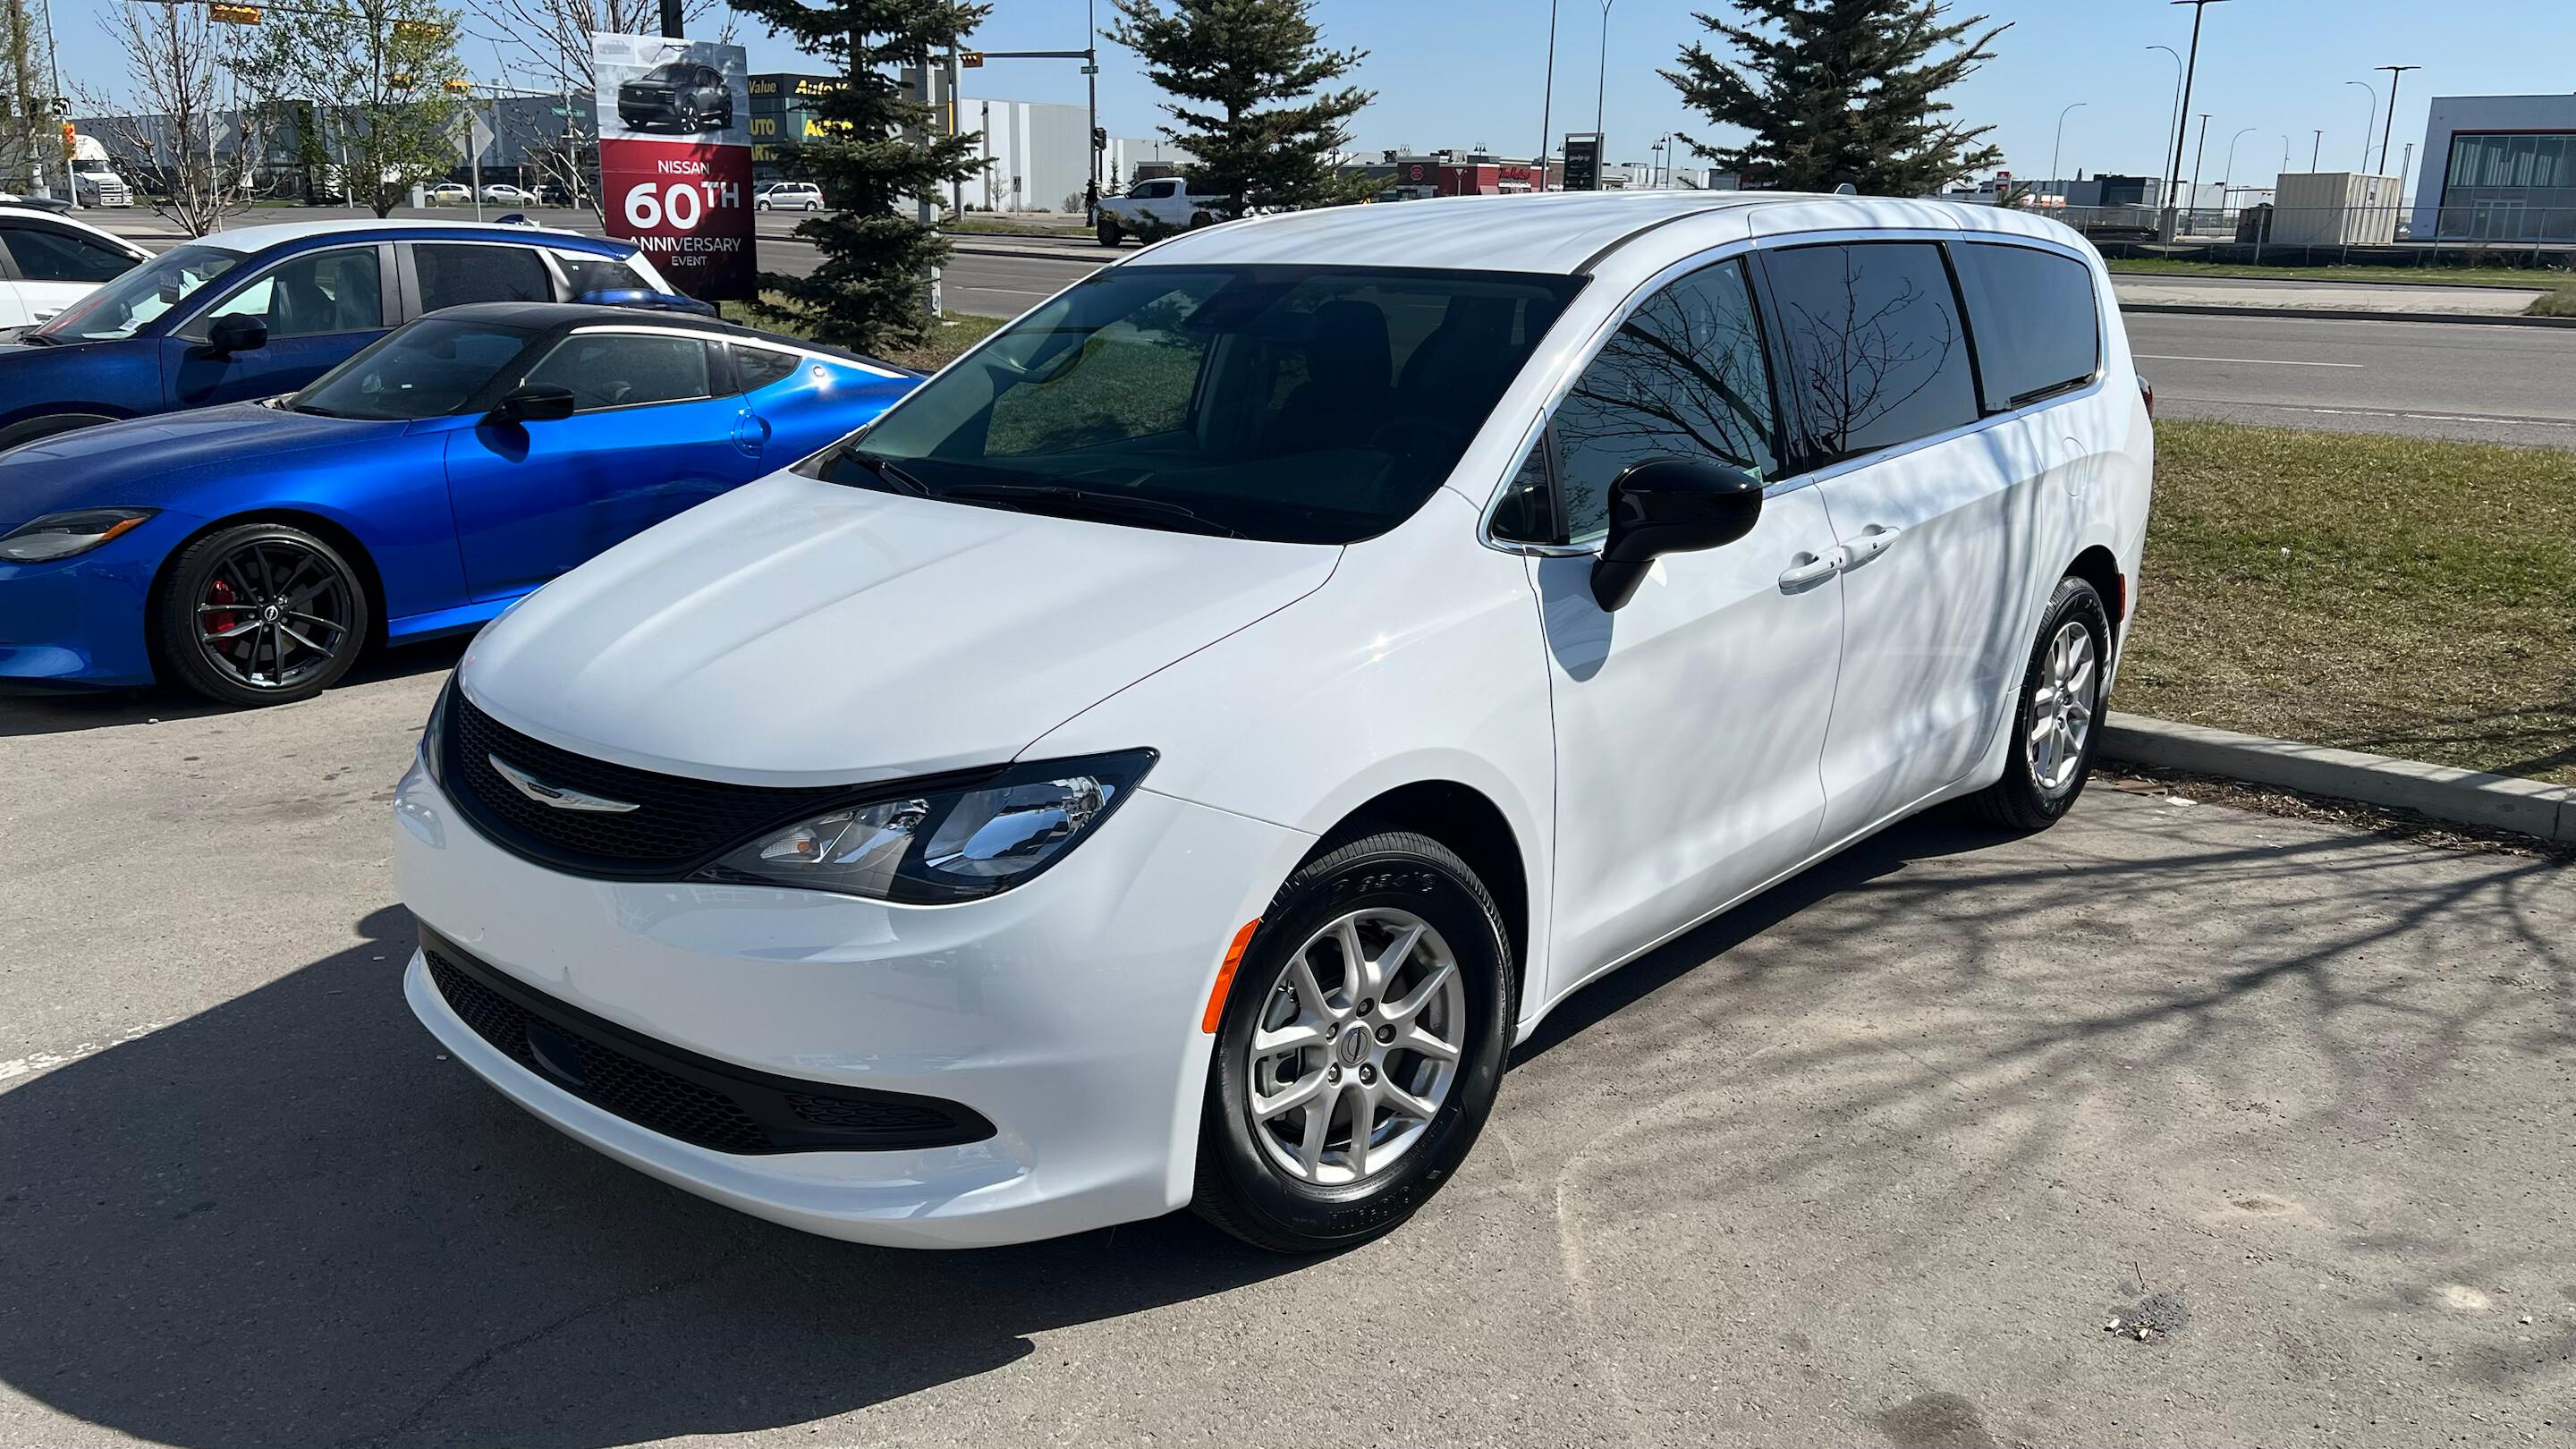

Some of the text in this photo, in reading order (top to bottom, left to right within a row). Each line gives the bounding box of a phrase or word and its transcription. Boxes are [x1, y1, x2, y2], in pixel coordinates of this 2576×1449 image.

[749, 80, 777, 94] Value
[750, 118, 775, 136] UTO
[657, 159, 710, 175] NISSAN
[624, 181, 740, 230] 60TH
[671, 255, 708, 267] EVENT
